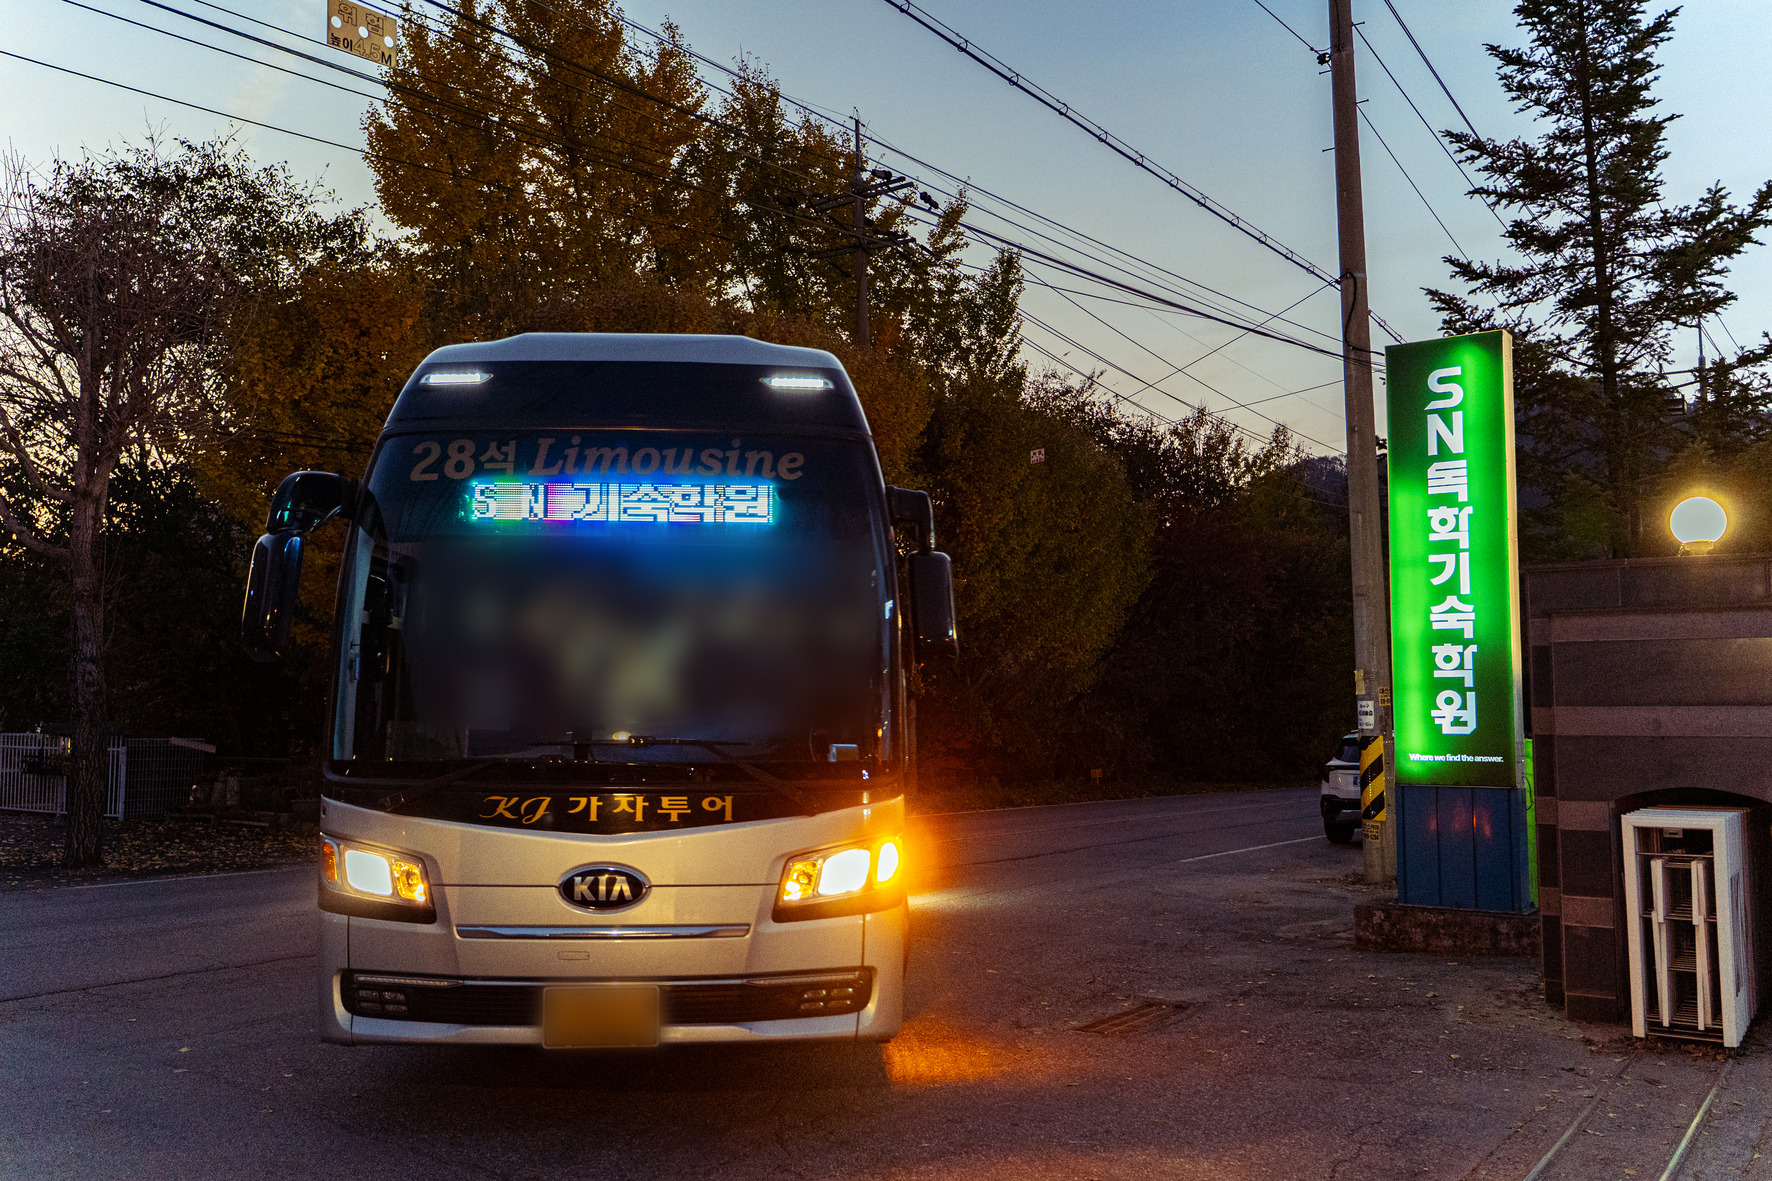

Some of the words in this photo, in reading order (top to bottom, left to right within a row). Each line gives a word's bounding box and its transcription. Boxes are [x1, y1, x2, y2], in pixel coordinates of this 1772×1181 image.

[410, 438, 517, 482] 28석
[528, 435, 806, 480] Limousine
[1424, 365, 1478, 735] SN독학기숙학원
[1409, 753, 1434, 762] Where
[1446, 753, 1461, 763] find
[1461, 754, 1474, 762] the
[568, 795, 734, 822] 가자투어
[573, 876, 634, 901] KIA
